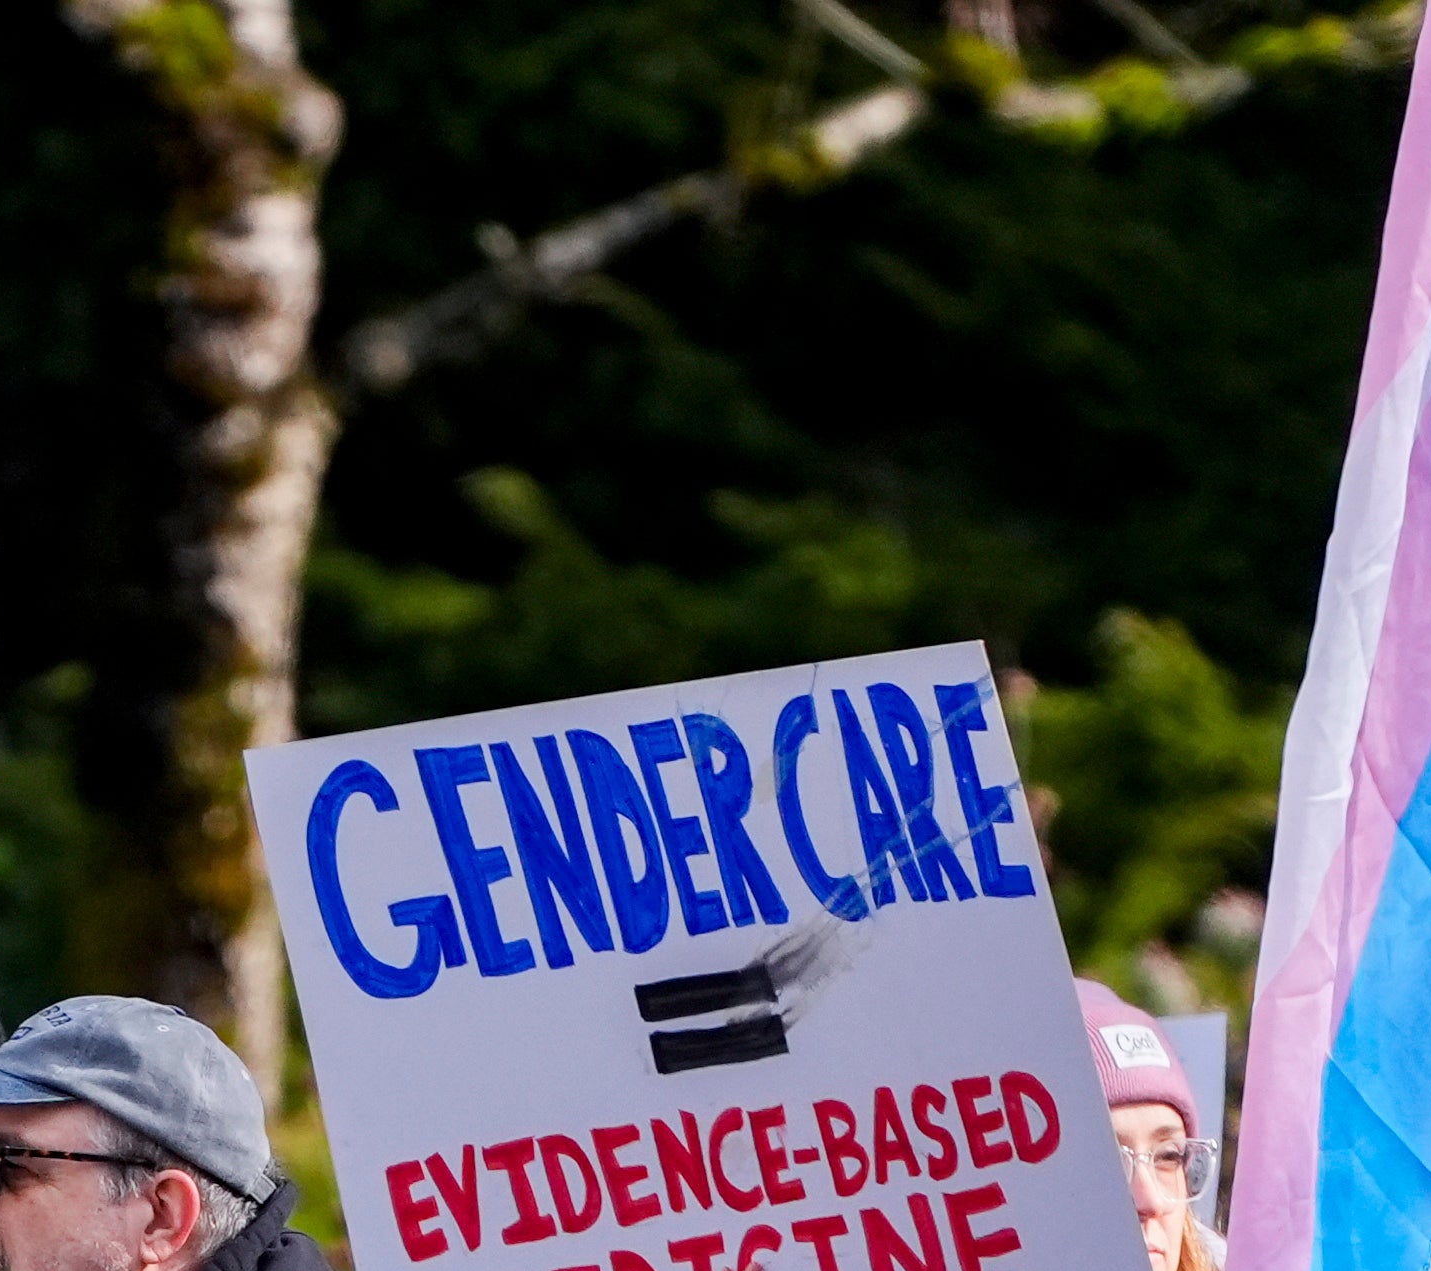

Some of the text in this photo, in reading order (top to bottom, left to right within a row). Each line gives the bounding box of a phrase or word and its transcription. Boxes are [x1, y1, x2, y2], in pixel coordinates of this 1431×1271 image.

[306, 681, 1036, 999] GENDER CARE
[386, 1070, 1061, 1263] EVIDENCE-BASED
